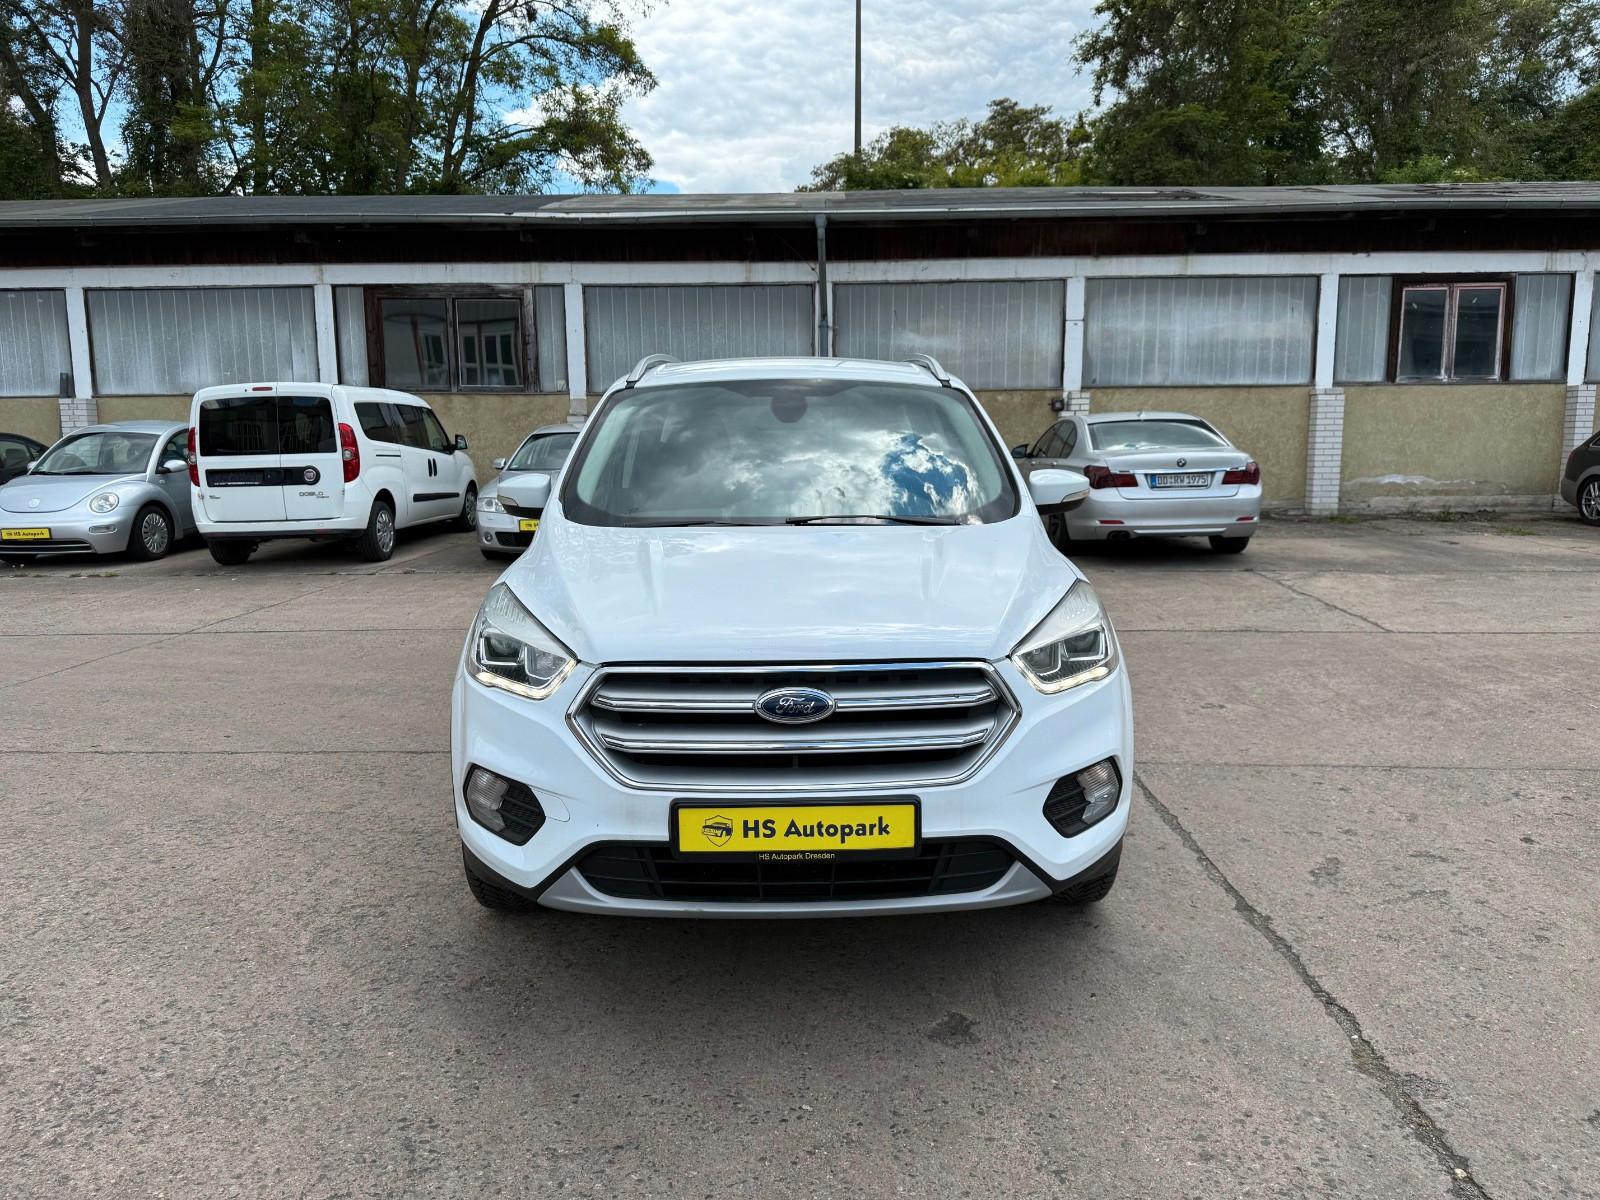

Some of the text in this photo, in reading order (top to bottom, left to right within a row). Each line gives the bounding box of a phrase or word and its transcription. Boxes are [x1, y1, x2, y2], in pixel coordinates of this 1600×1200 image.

[1186, 473, 1207, 484] 1975
[22, 530, 45, 538] Autopark
[775, 696, 816, 714] Ford
[742, 816, 890, 844] HS Autopark
[771, 852, 804, 861] Autopark
[805, 852, 836, 860] Dresden
